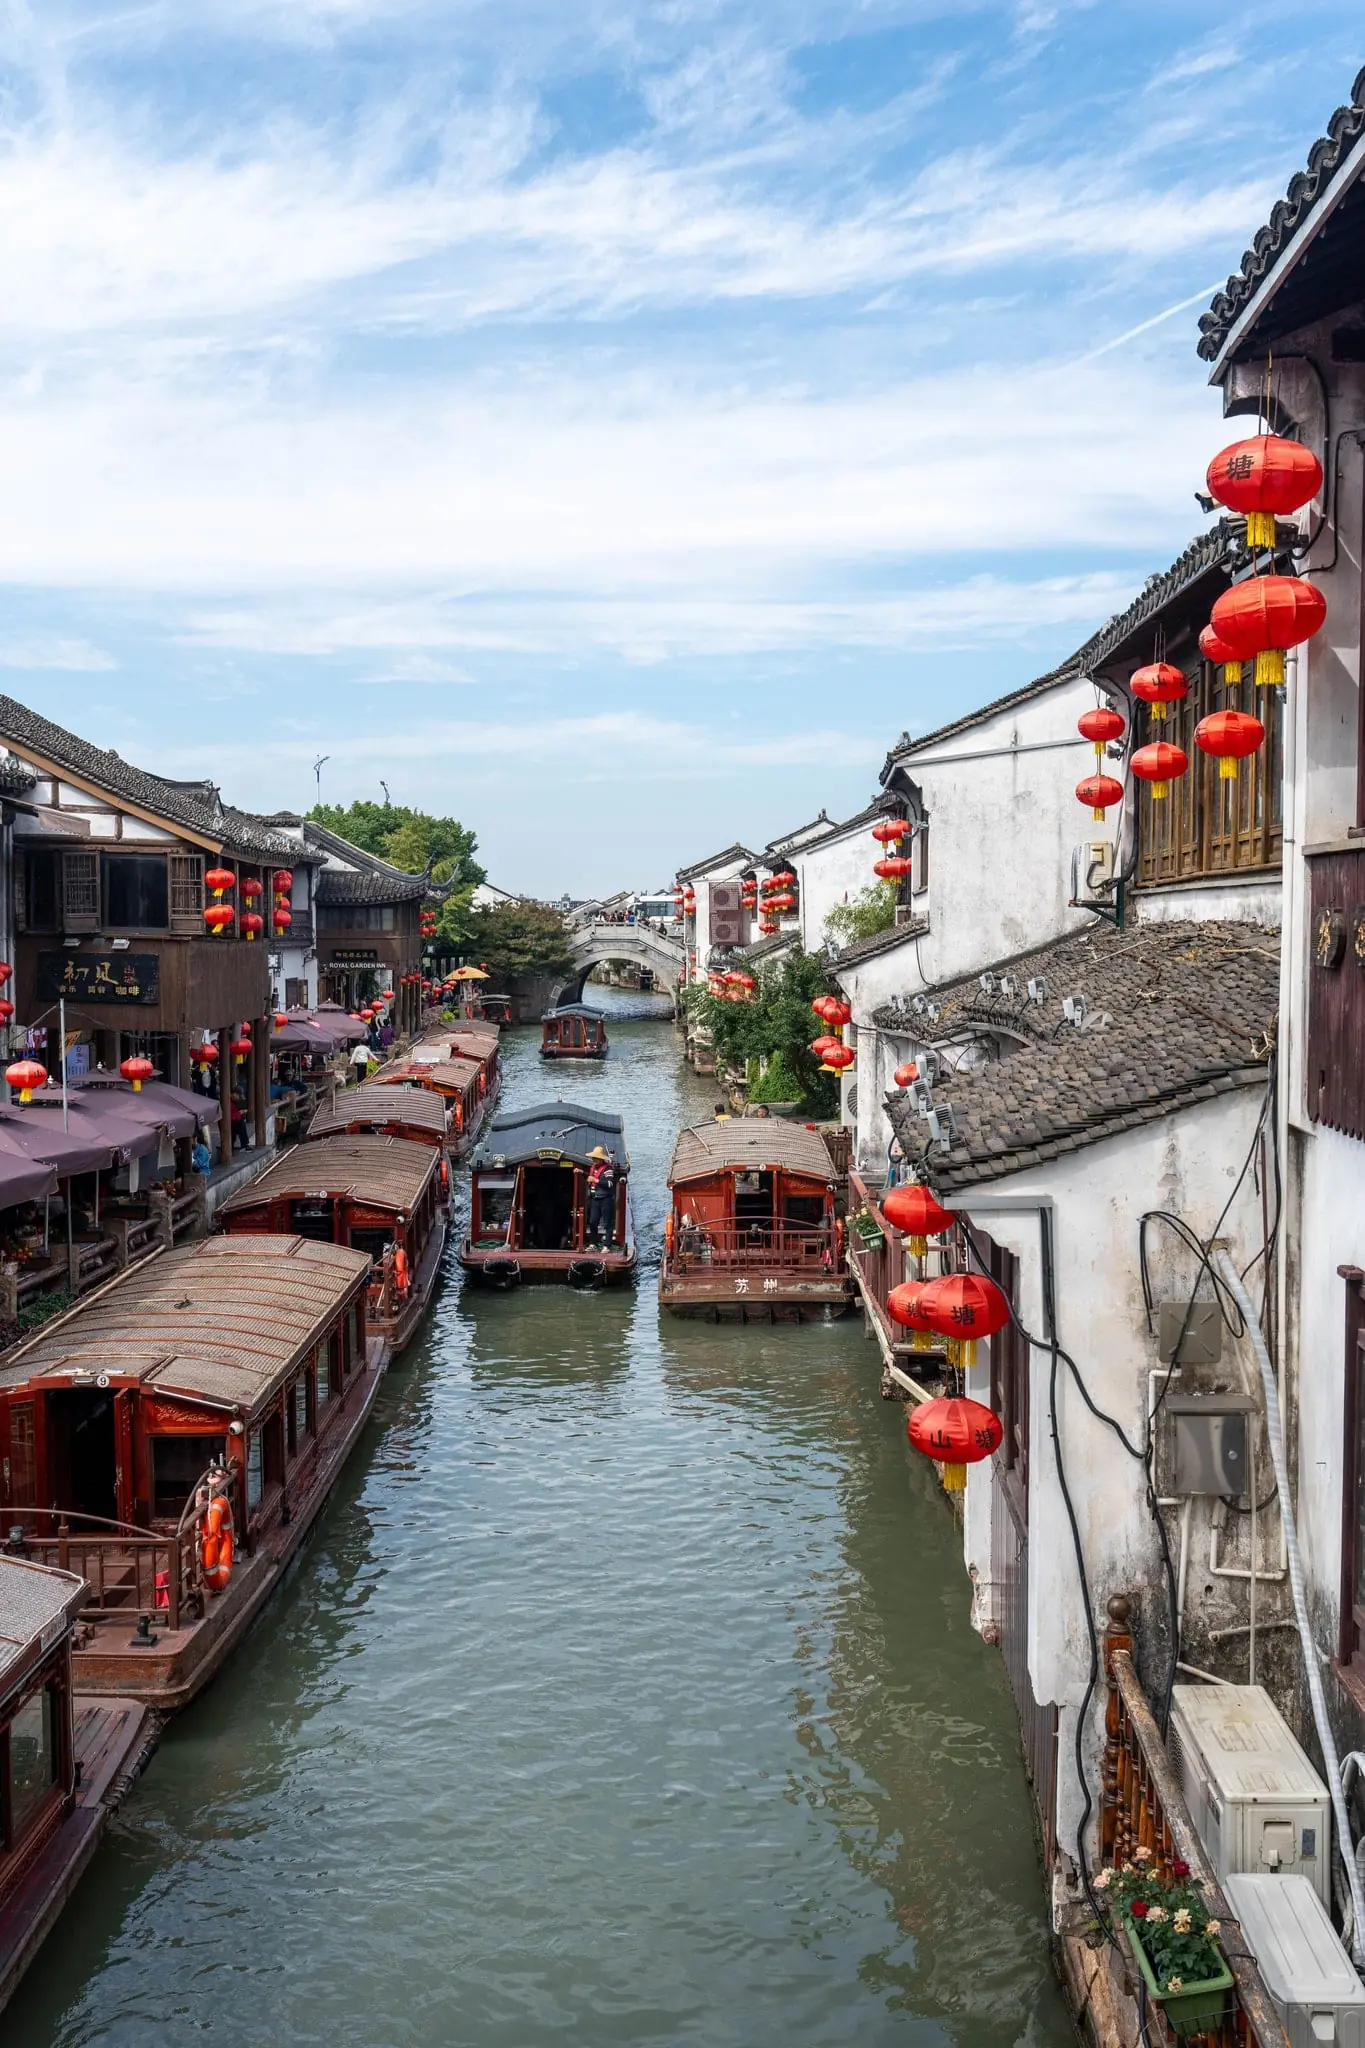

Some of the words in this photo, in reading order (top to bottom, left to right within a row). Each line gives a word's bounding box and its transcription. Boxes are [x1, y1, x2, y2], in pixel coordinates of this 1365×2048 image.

[1225, 455, 1255, 480] 塘
[115, 985, 140, 996] 咖啡
[734, 1278, 778, 1294] 苏州
[951, 1304, 976, 1325] 塘
